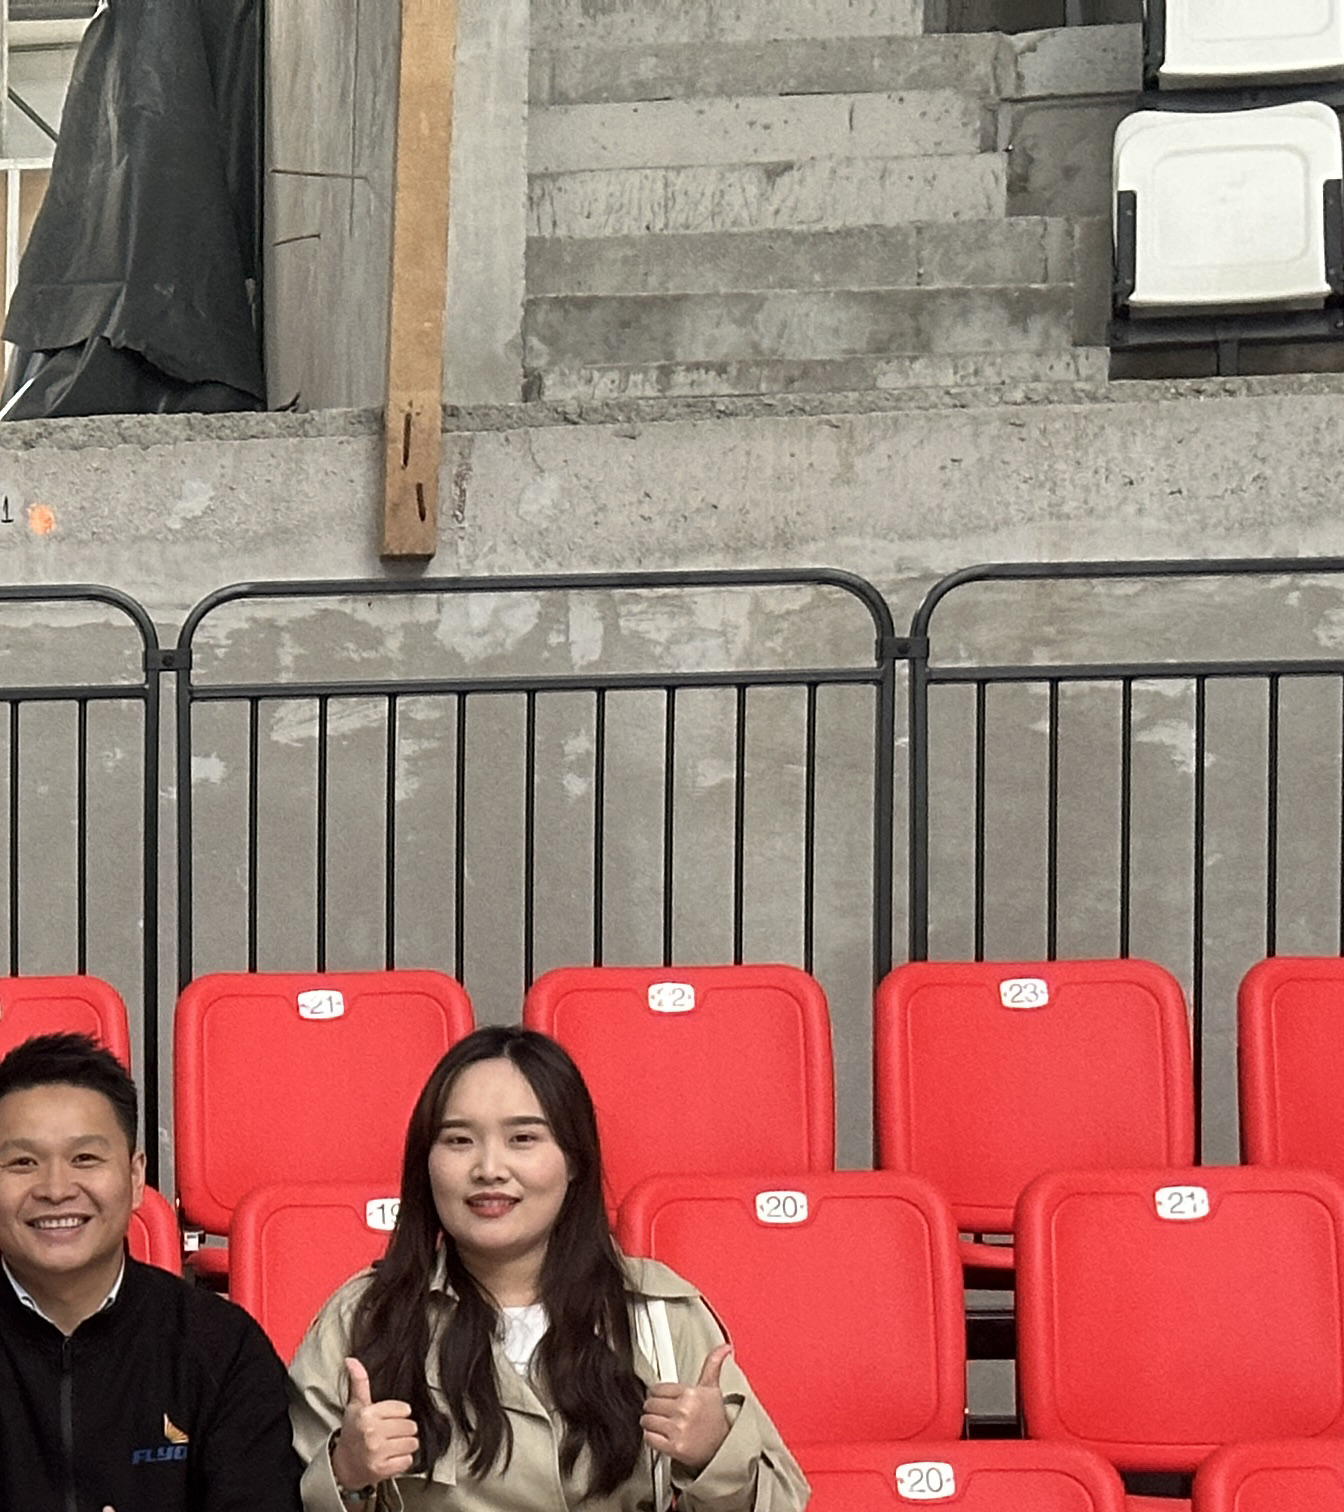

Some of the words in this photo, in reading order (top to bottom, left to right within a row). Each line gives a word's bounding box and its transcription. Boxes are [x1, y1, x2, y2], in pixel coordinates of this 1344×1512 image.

[1008, 983, 1040, 1004] 23
[310, 995, 334, 1015] 21
[765, 1195, 798, 1218] 20
[1167, 1191, 1198, 1214] 21
[132, 1445, 188, 1465] FLYO
[907, 1467, 944, 1493] 20
